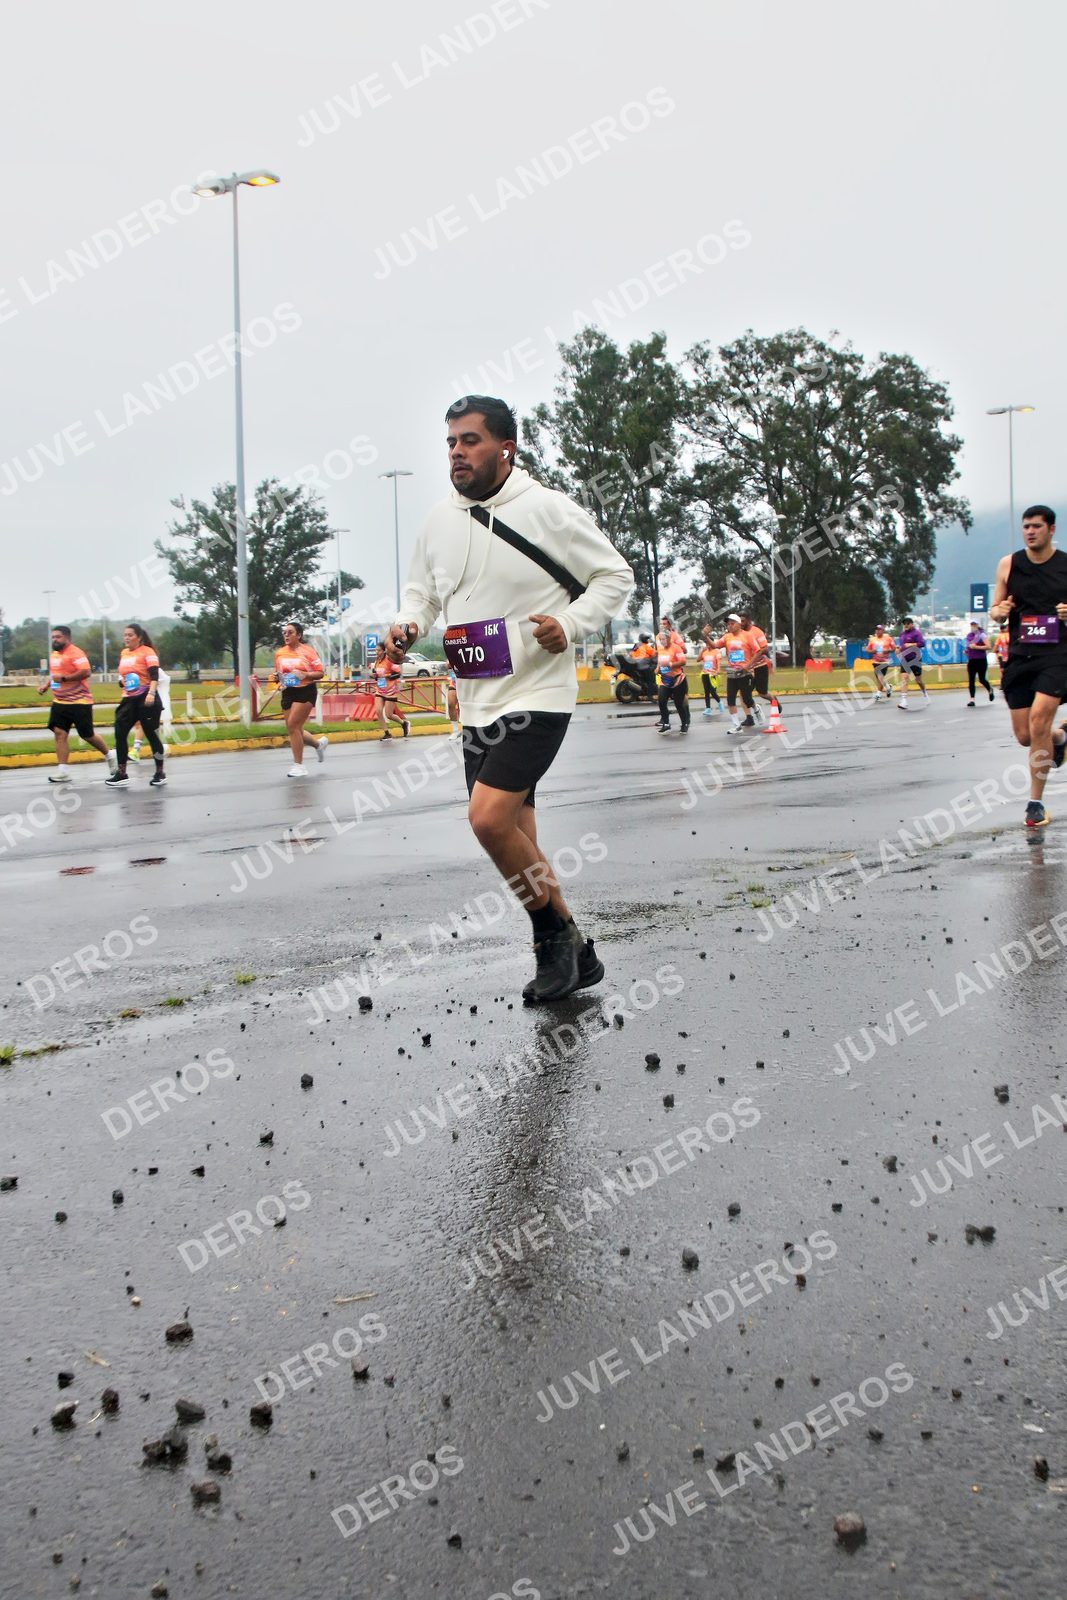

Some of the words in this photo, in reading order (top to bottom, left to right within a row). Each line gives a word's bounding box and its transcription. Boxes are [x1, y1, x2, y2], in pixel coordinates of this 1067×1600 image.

[973, 595, 984, 609] E
[1027, 626, 1047, 636] 246
[458, 646, 485, 663] 170
